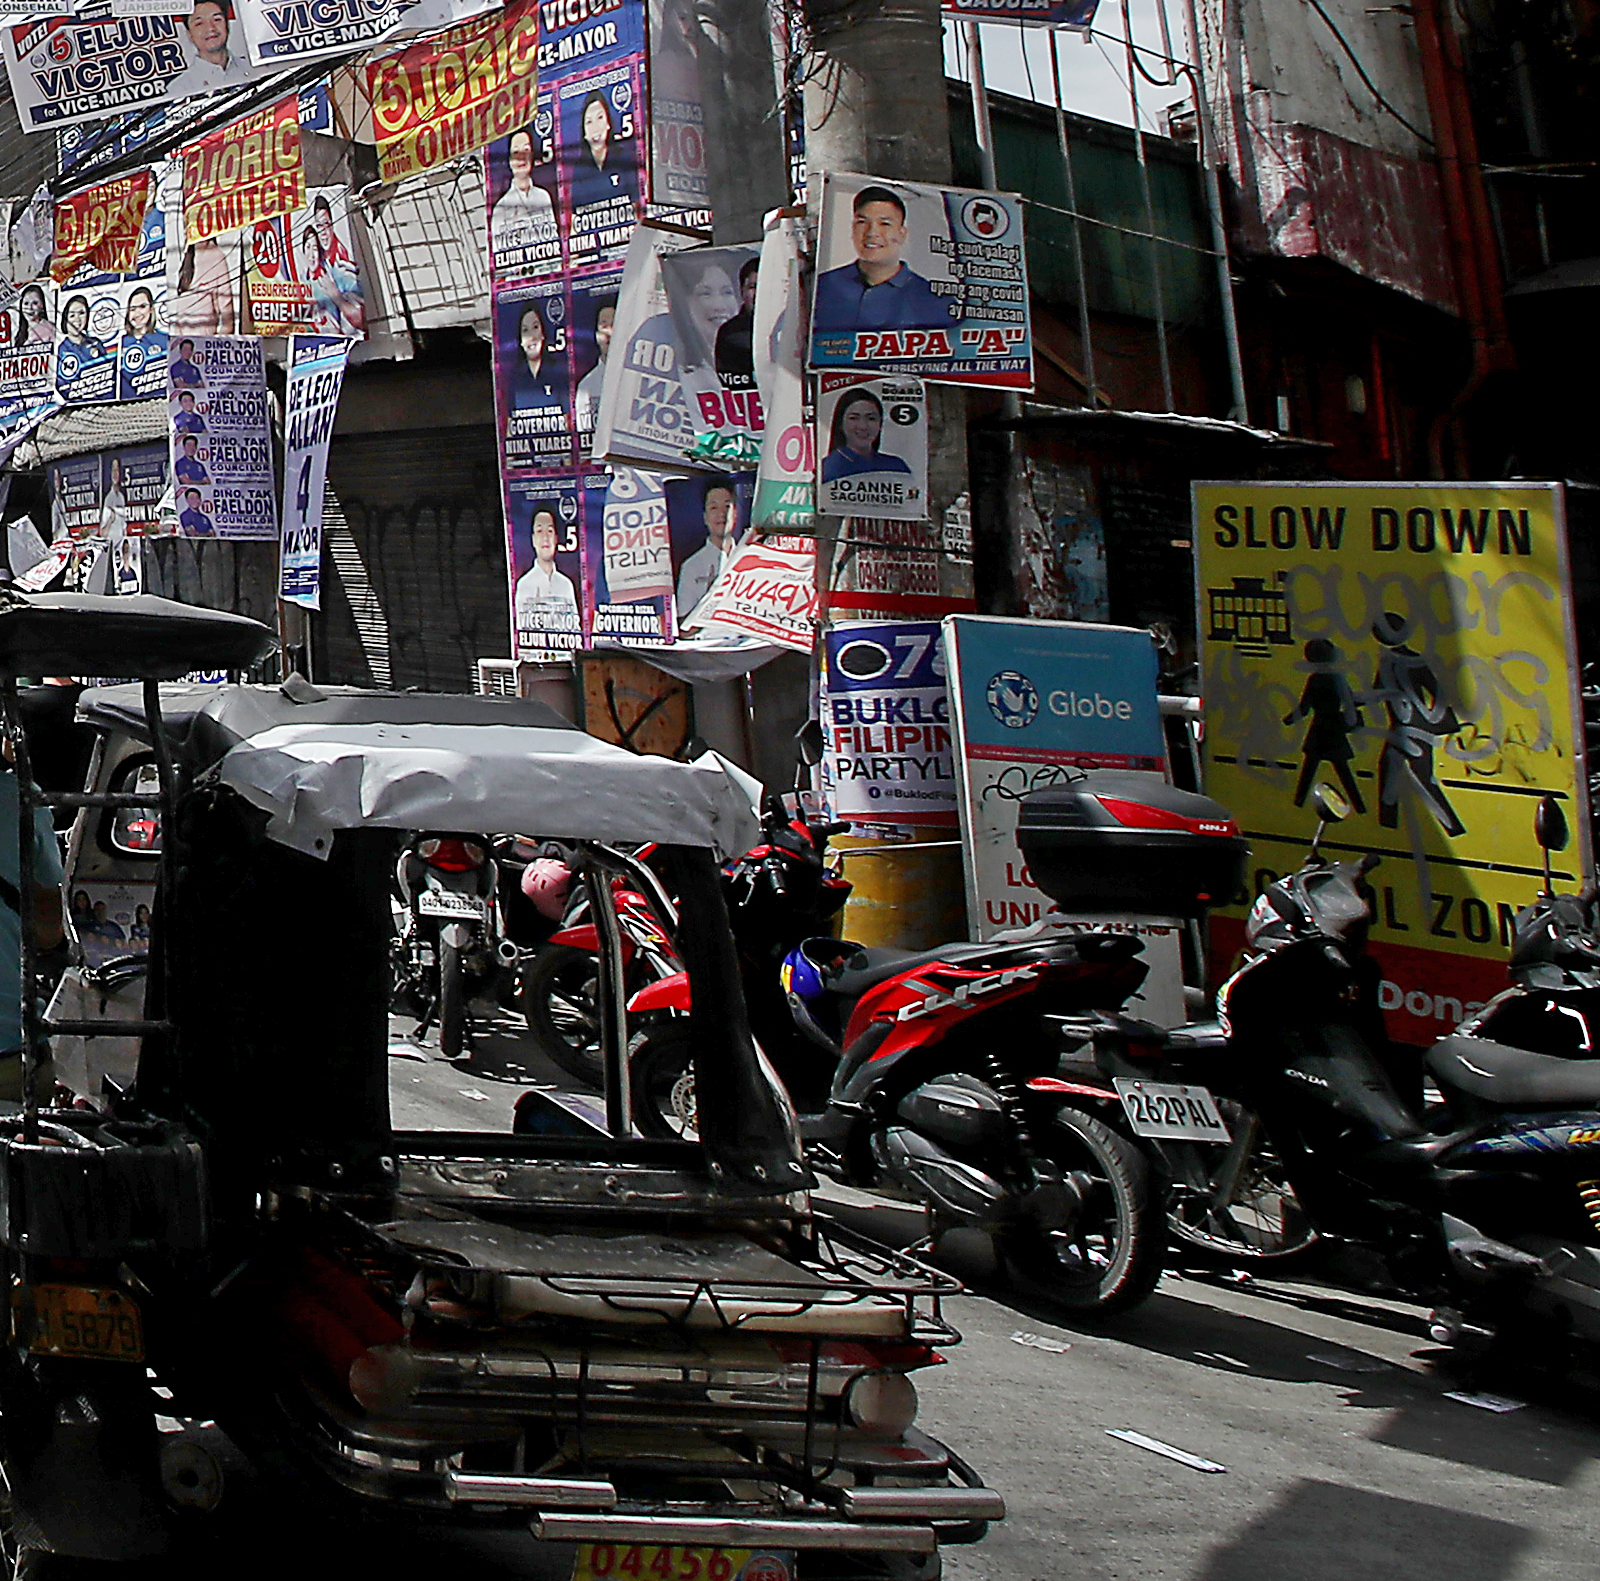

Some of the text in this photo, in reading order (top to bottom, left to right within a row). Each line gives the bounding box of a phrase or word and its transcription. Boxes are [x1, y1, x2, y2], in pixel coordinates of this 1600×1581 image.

[930, 236, 1021, 262] Mag suot palagi
[948, 261, 1022, 282] ng facemask
[930, 281, 1023, 302] upang ang covid
[948, 304, 1025, 322] ay maiwasan
[852, 330, 954, 360] PAPA
[205, 349, 262, 365] FAELDON
[950, 362, 971, 373] ALL
[972, 361, 996, 373] THE
[1000, 358, 1027, 372] WAY
[829, 479, 904, 496] JO ANNE
[829, 491, 904, 505] SAGUINSIN
[213, 499, 274, 515] FAELDON
[1213, 504, 1533, 557] SLOW DOWN
[1048, 690, 1133, 721] Globe
[898, 964, 1039, 1022] CLICK
[1126, 1092, 1222, 1130] 262PAL
